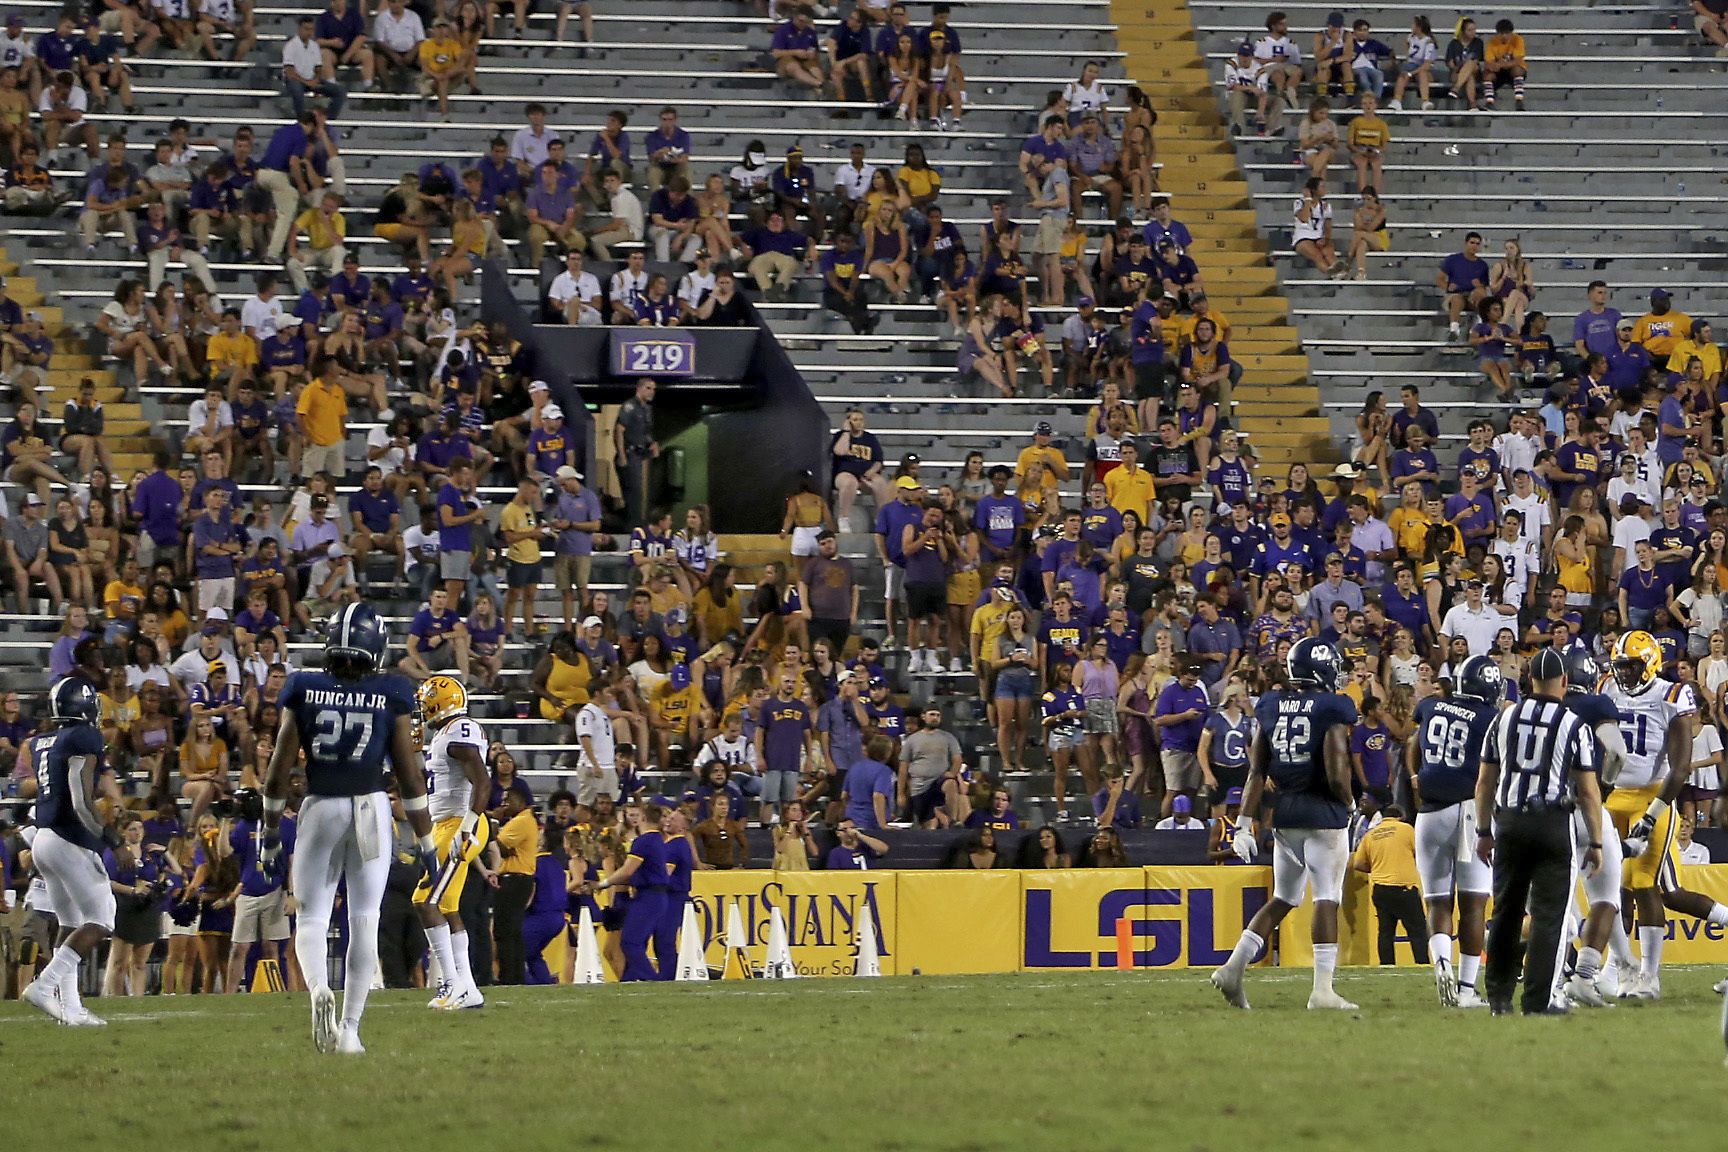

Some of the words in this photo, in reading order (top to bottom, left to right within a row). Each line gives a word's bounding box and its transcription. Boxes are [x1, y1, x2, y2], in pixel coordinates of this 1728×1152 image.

[632, 345, 683, 370] 219
[1637, 464, 1649, 480] 5
[1311, 645, 1329, 660] 42
[1484, 666, 1501, 682] 98
[305, 689, 364, 707] DUNCAN
[366, 693, 386, 710] JR
[1279, 700, 1303, 714] WARD
[1303, 700, 1313, 714] JR
[773, 709, 803, 721] LSU
[1434, 701, 1477, 721] SPRINGER
[311, 710, 374, 761] 27
[461, 723, 470, 738] 5
[1272, 716, 1312, 763] 42
[1425, 716, 1470, 769] 98
[1515, 723, 1547, 772] U
[1025, 887, 1268, 968] LSU
[795, 960, 827, 975] Your
